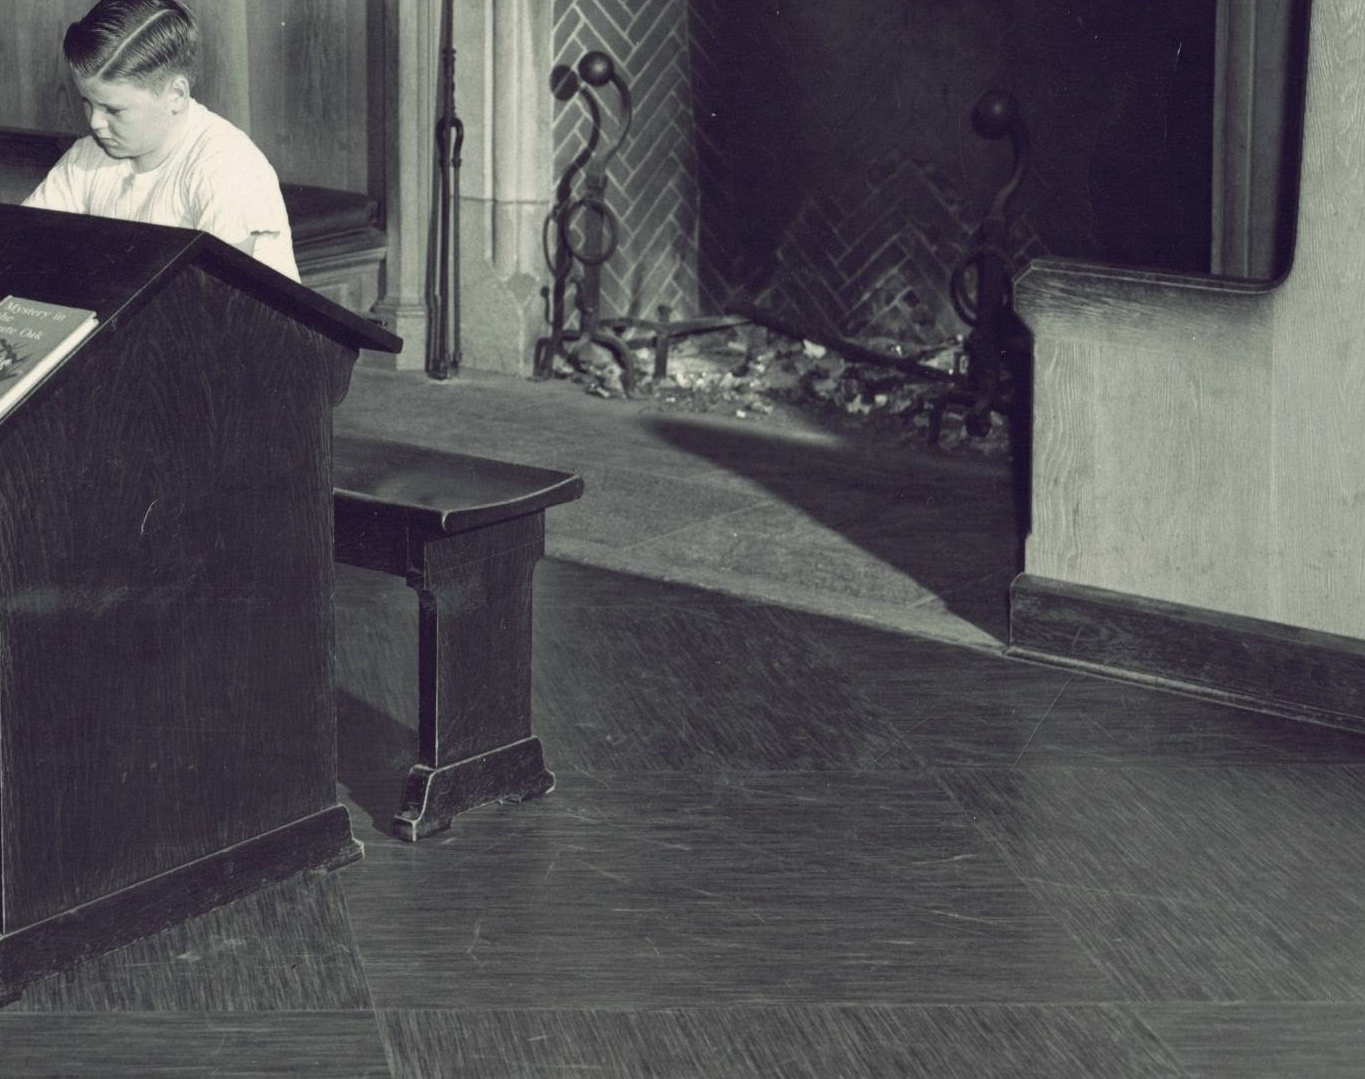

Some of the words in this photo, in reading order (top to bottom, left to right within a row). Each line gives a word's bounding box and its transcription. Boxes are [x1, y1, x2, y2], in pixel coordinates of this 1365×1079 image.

[5, 302, 48, 319] Mystery
[54, 311, 66, 321] in
[20, 329, 43, 340] Oak
